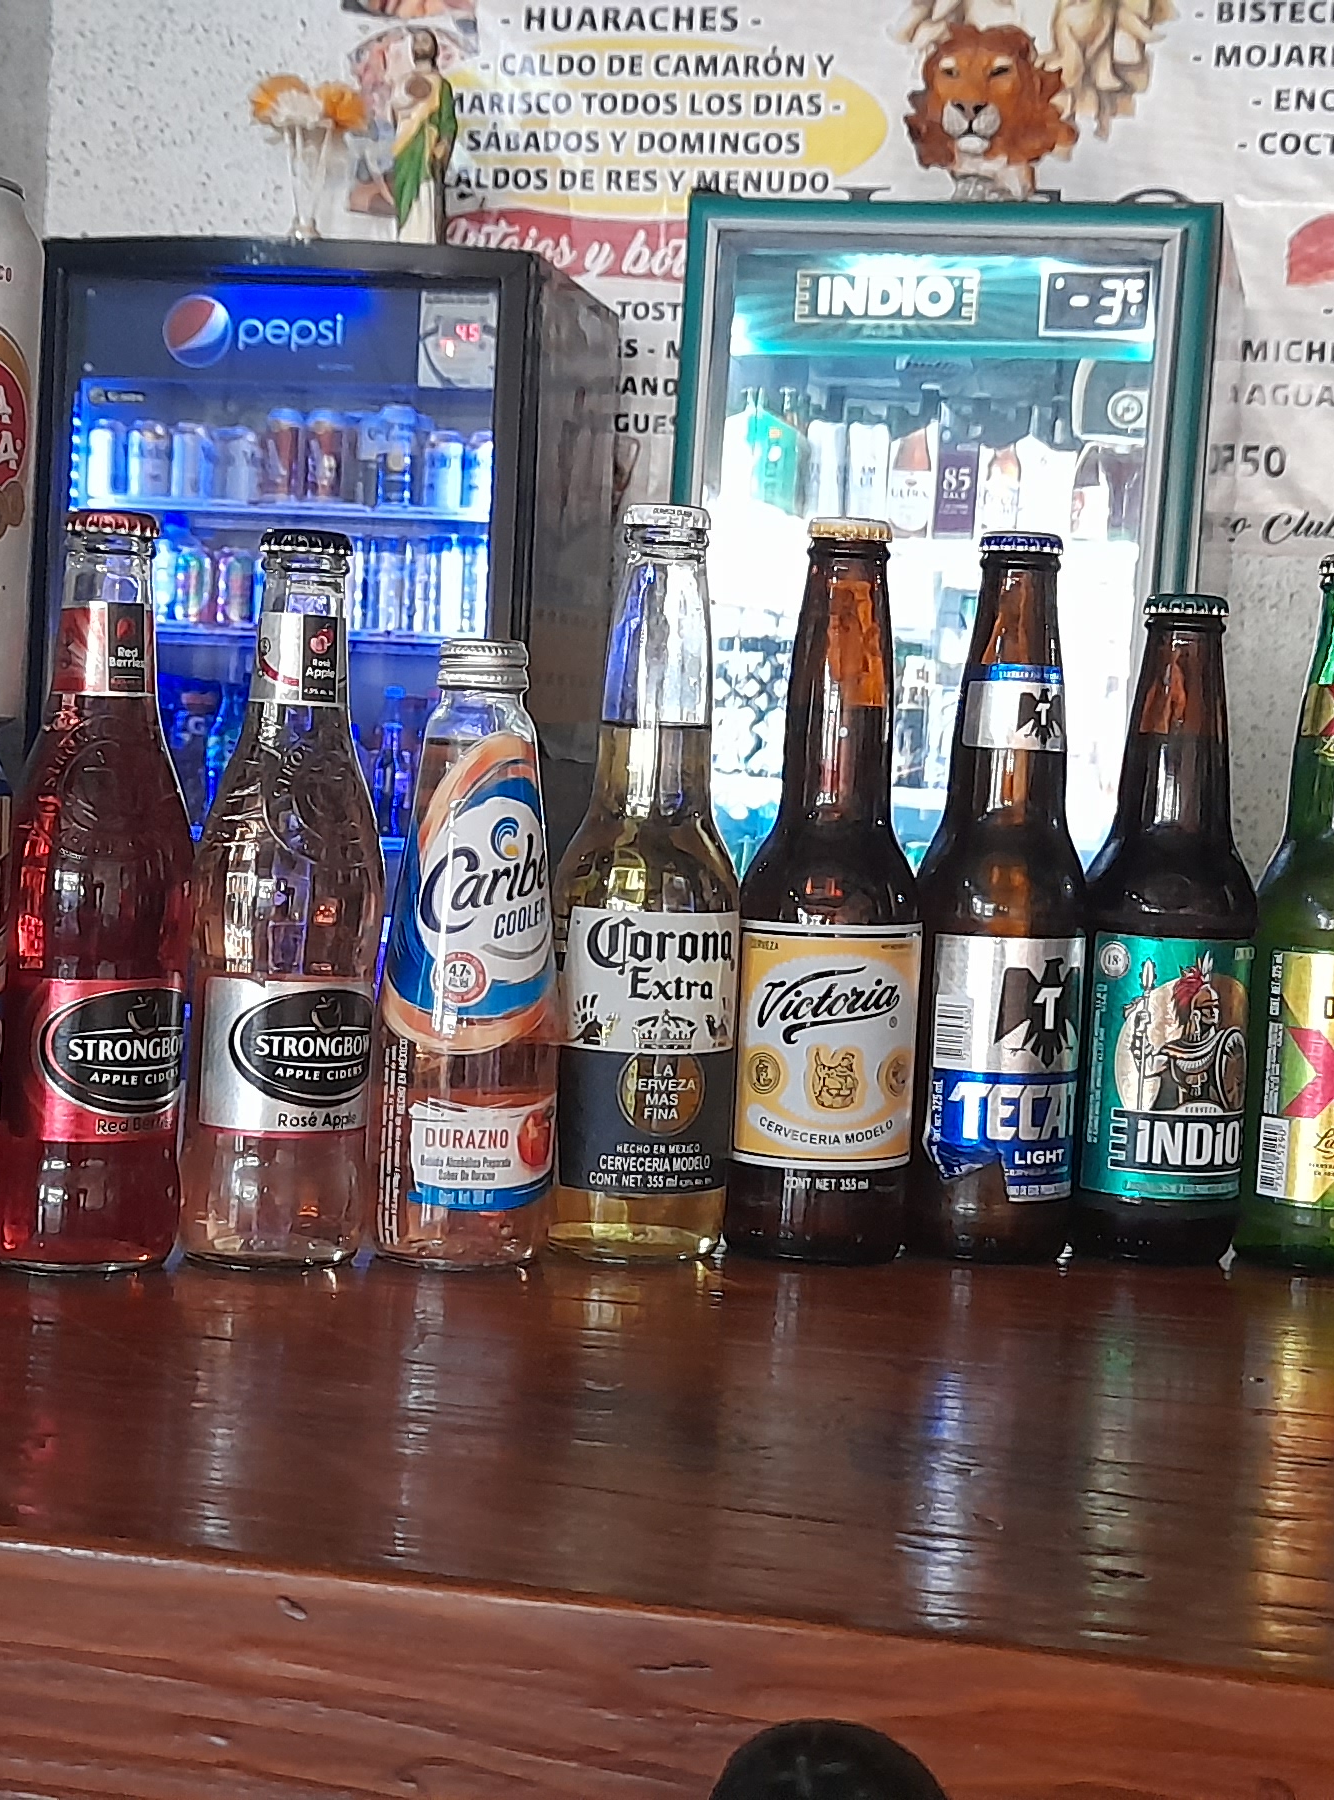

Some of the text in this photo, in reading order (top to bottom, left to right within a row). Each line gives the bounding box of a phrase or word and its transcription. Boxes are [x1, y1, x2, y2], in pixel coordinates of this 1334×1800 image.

[524, 7, 739, 32] HUARACHES
[500, 46, 834, 78] CALDO DE CAMARÓN Y
[581, 92, 677, 116] TODOS
[688, 93, 743, 116] LOS
[754, 93, 822, 116] DIAS
[467, 122, 801, 155] SÁBADOS Y DOMINGOS
[559, 169, 594, 191] DE
[606, 169, 657, 191] RES
[669, 169, 687, 191] Y
[696, 171, 830, 194] MENUDO
[817, 275, 956, 318] INDIO
[238, 311, 345, 352] pepsi
[942, 466, 972, 492] 85
[117, 646, 139, 658] Red
[306, 667, 336, 679] Apple
[419, 832, 547, 935] Caribe
[586, 916, 733, 976] Corona
[627, 966, 714, 1001] Extra
[757, 965, 901, 1045] Victoria
[89, 1070, 139, 1086] APPLE
[274, 1065, 363, 1081] APPLE CIDERS
[653, 1065, 674, 1077] LA
[645, 1093, 679, 1106] MAS
[277, 1111, 319, 1128] Rosé
[643, 1107, 679, 1120] FINA
[96, 1118, 129, 1134] Red
[759, 1116, 894, 1146] CERVECERIA MODELO
[425, 1127, 509, 1150] DURAZNO
[616, 1144, 650, 1154] HECHO
[653, 1144, 666, 1154] EN
[1135, 1119, 1241, 1167] INDIO
[599, 1155, 711, 1172] CERVECERIA MODELO
[1014, 1149, 1065, 1165] LIGHT
[589, 1172, 664, 1188] CONT. NET. 355
[816, 1177, 837, 1190] NET
